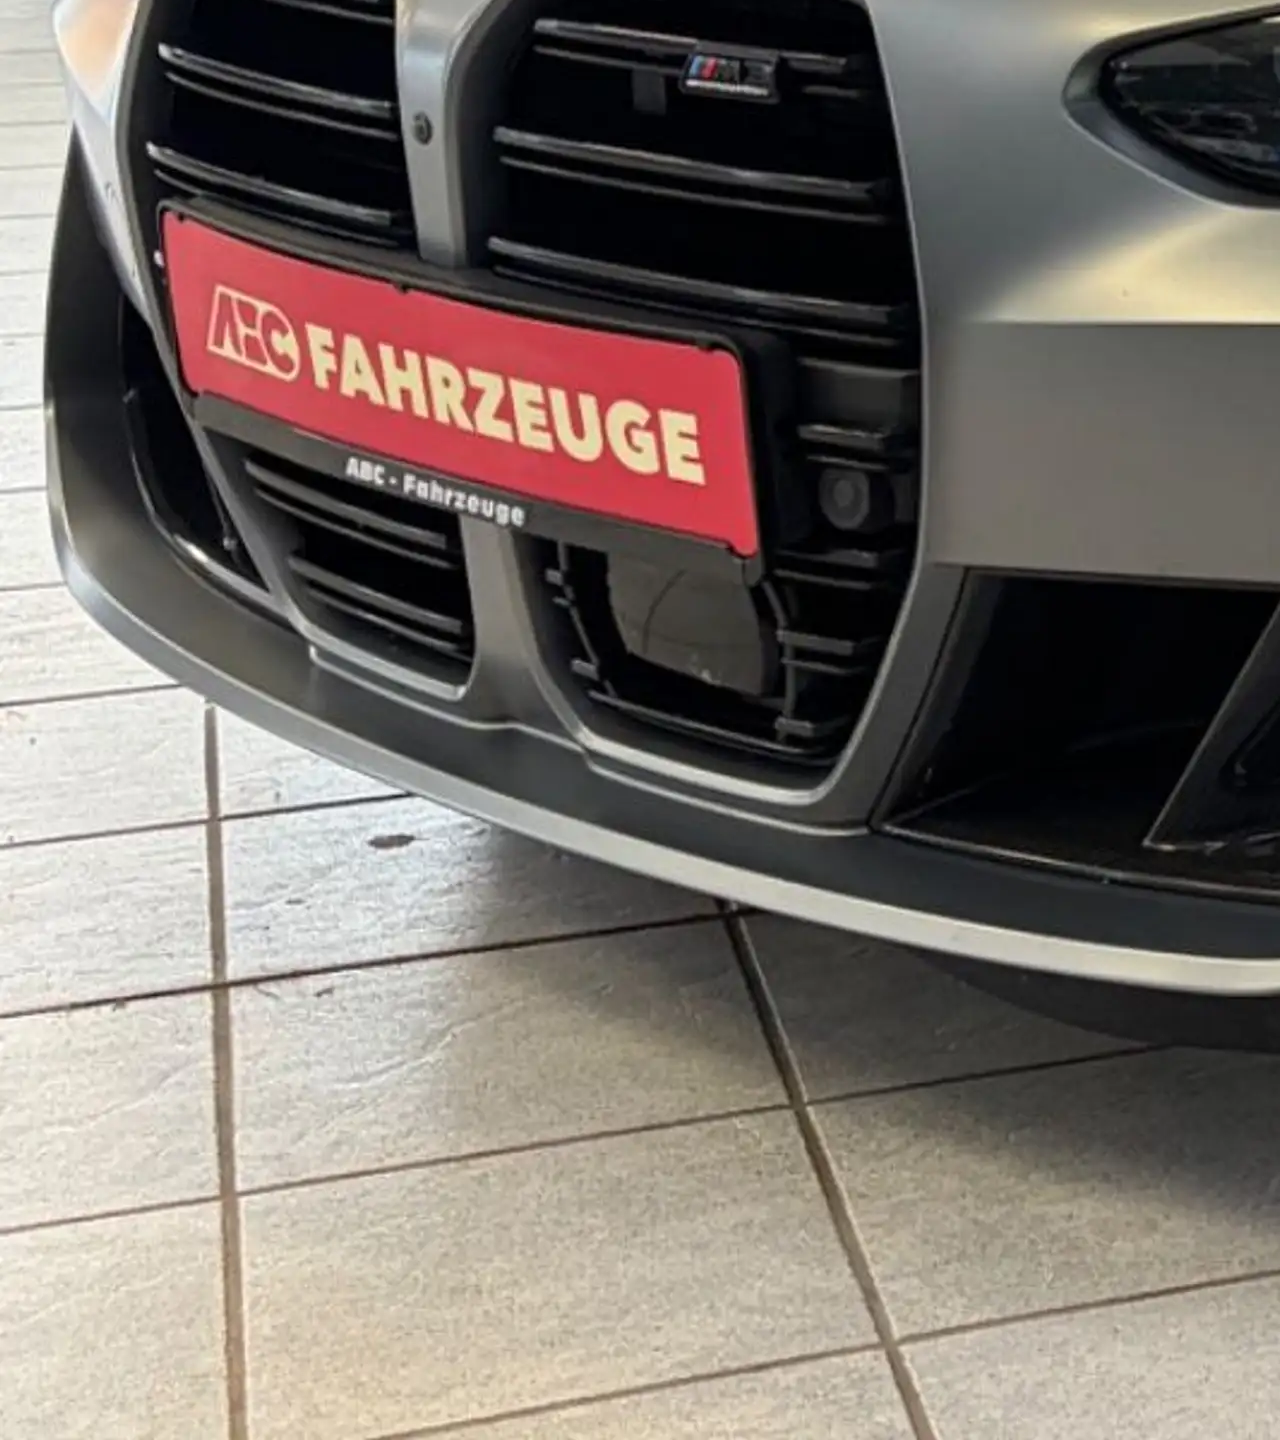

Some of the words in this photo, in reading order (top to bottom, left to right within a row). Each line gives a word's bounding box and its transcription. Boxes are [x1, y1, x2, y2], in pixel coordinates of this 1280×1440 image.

[304, 321, 707, 487] FAHRZEUGE
[345, 456, 385, 486] ABC
[403, 472, 526, 527] Fahrzeuge
